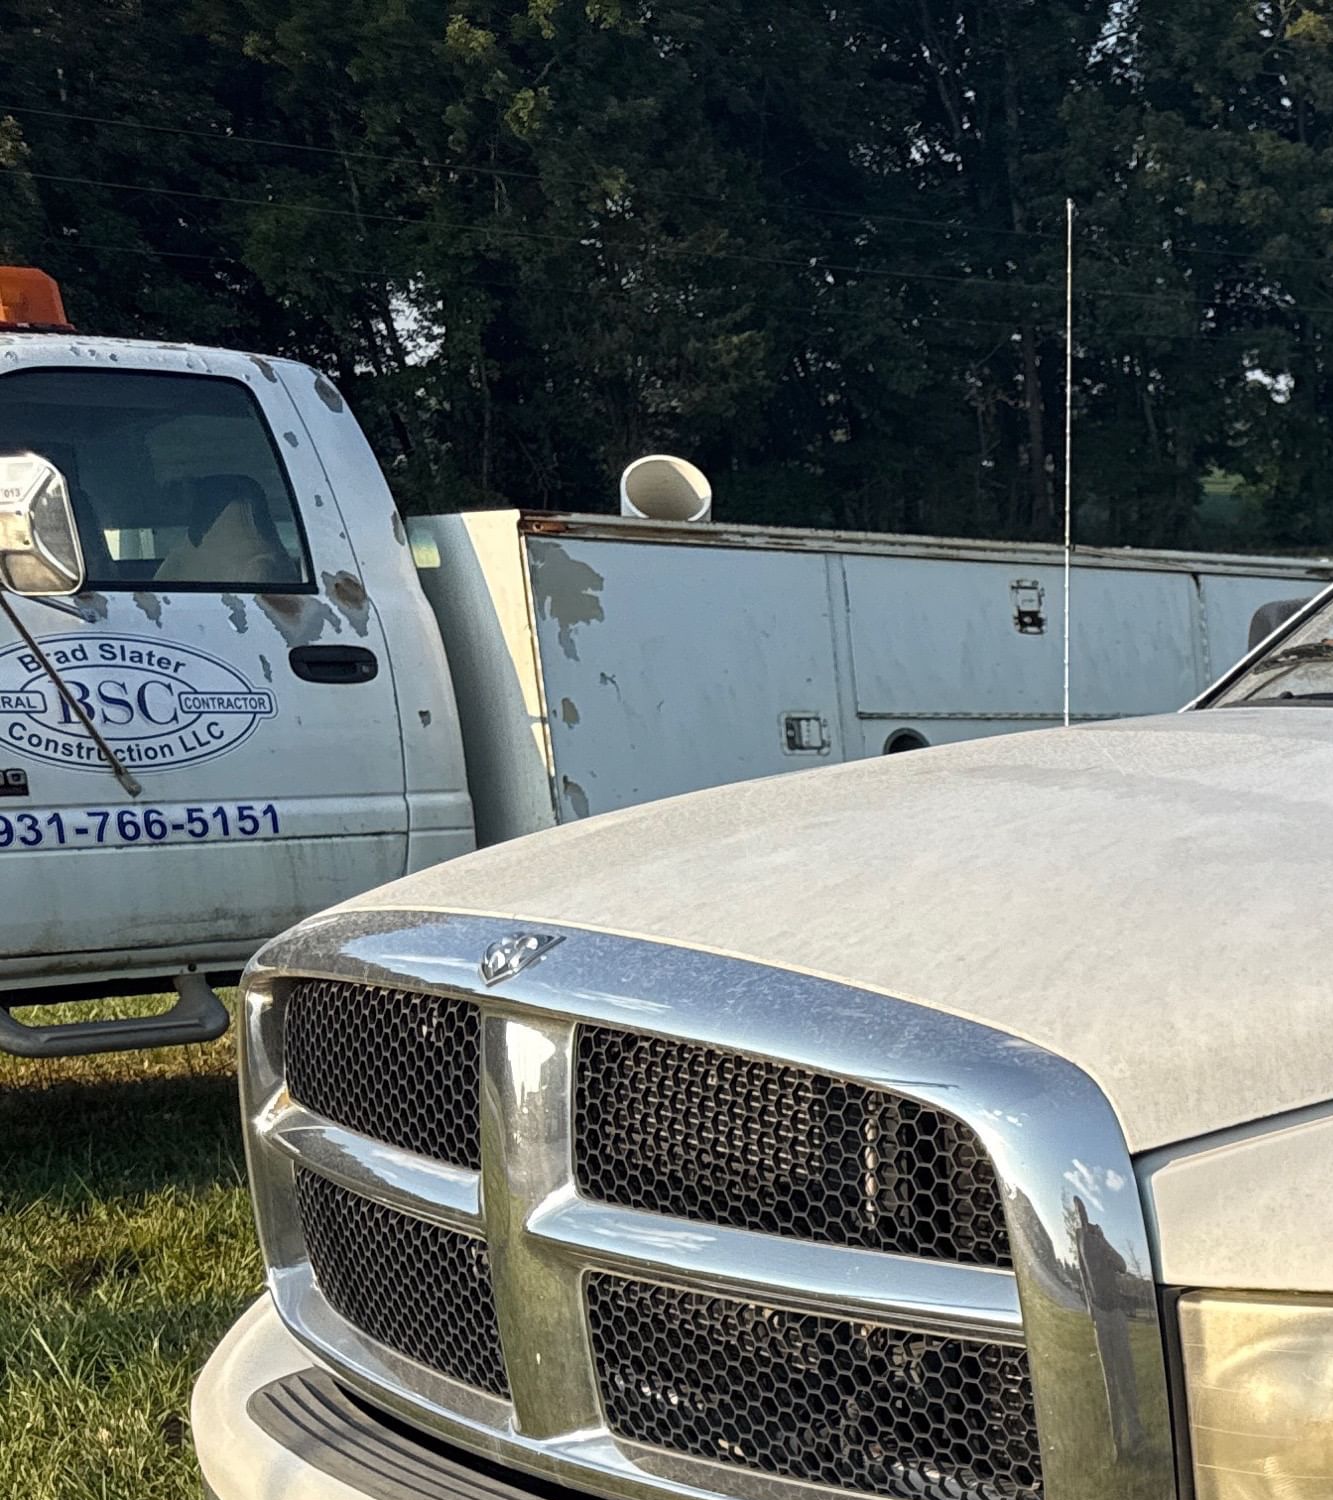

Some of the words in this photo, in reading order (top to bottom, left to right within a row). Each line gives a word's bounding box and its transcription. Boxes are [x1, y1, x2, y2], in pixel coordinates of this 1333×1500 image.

[17, 643, 88, 673] Bad
[98, 643, 187, 673] Slater
[0, 696, 37, 708] RAL
[184, 696, 267, 710] CONTRACTOR
[48, 680, 180, 725] BSC
[179, 721, 224, 753] LLC
[0, 804, 280, 847] 931-766-5151
